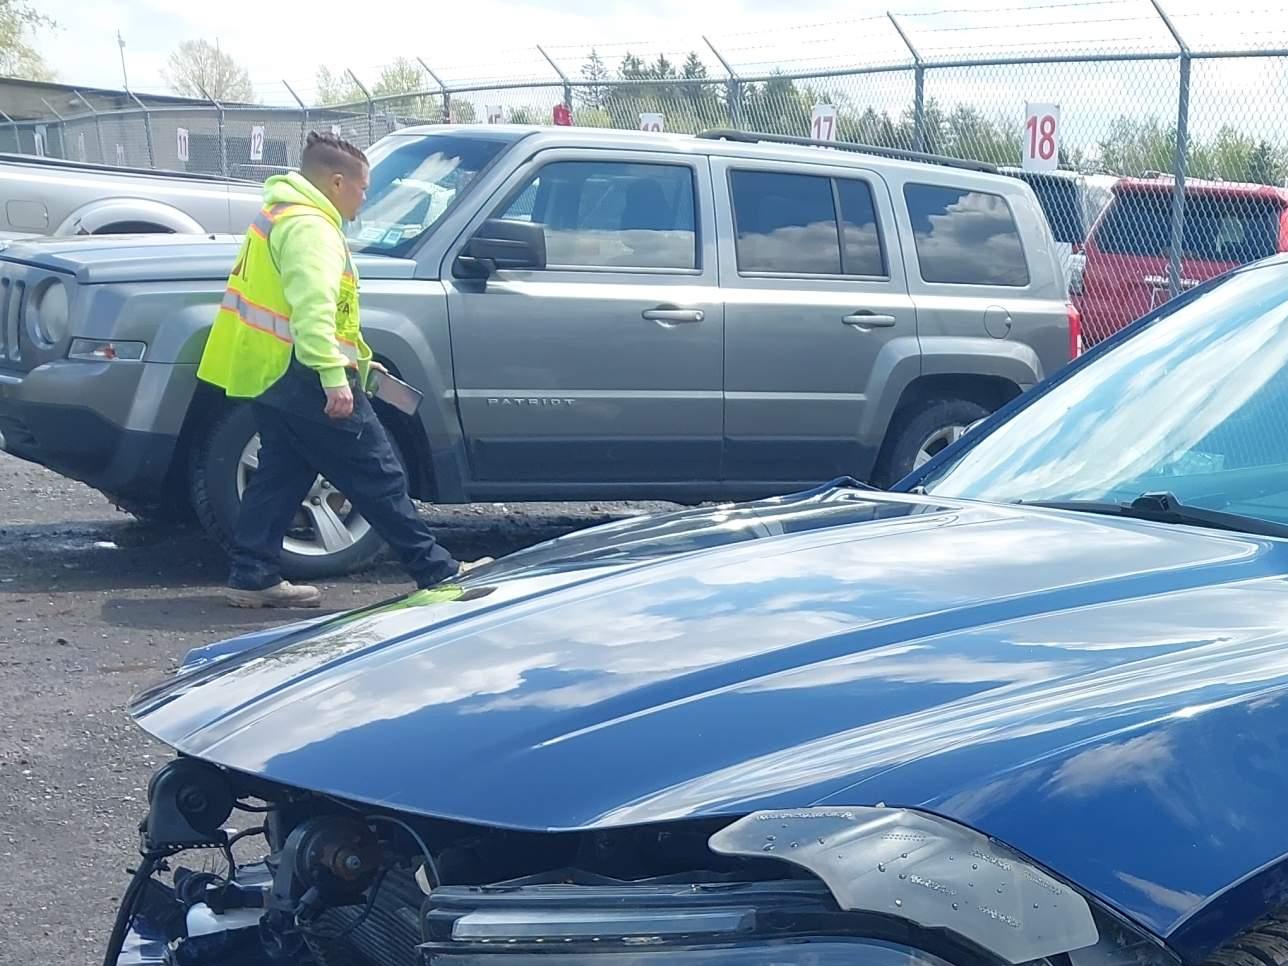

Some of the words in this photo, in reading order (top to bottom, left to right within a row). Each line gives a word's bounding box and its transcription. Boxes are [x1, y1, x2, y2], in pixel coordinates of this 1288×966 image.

[813, 115, 833, 141] 17
[1026, 115, 1056, 161] 18
[178, 134, 188, 158] 11
[251, 132, 263, 155] 12
[486, 397, 577, 408] PATRIOT
